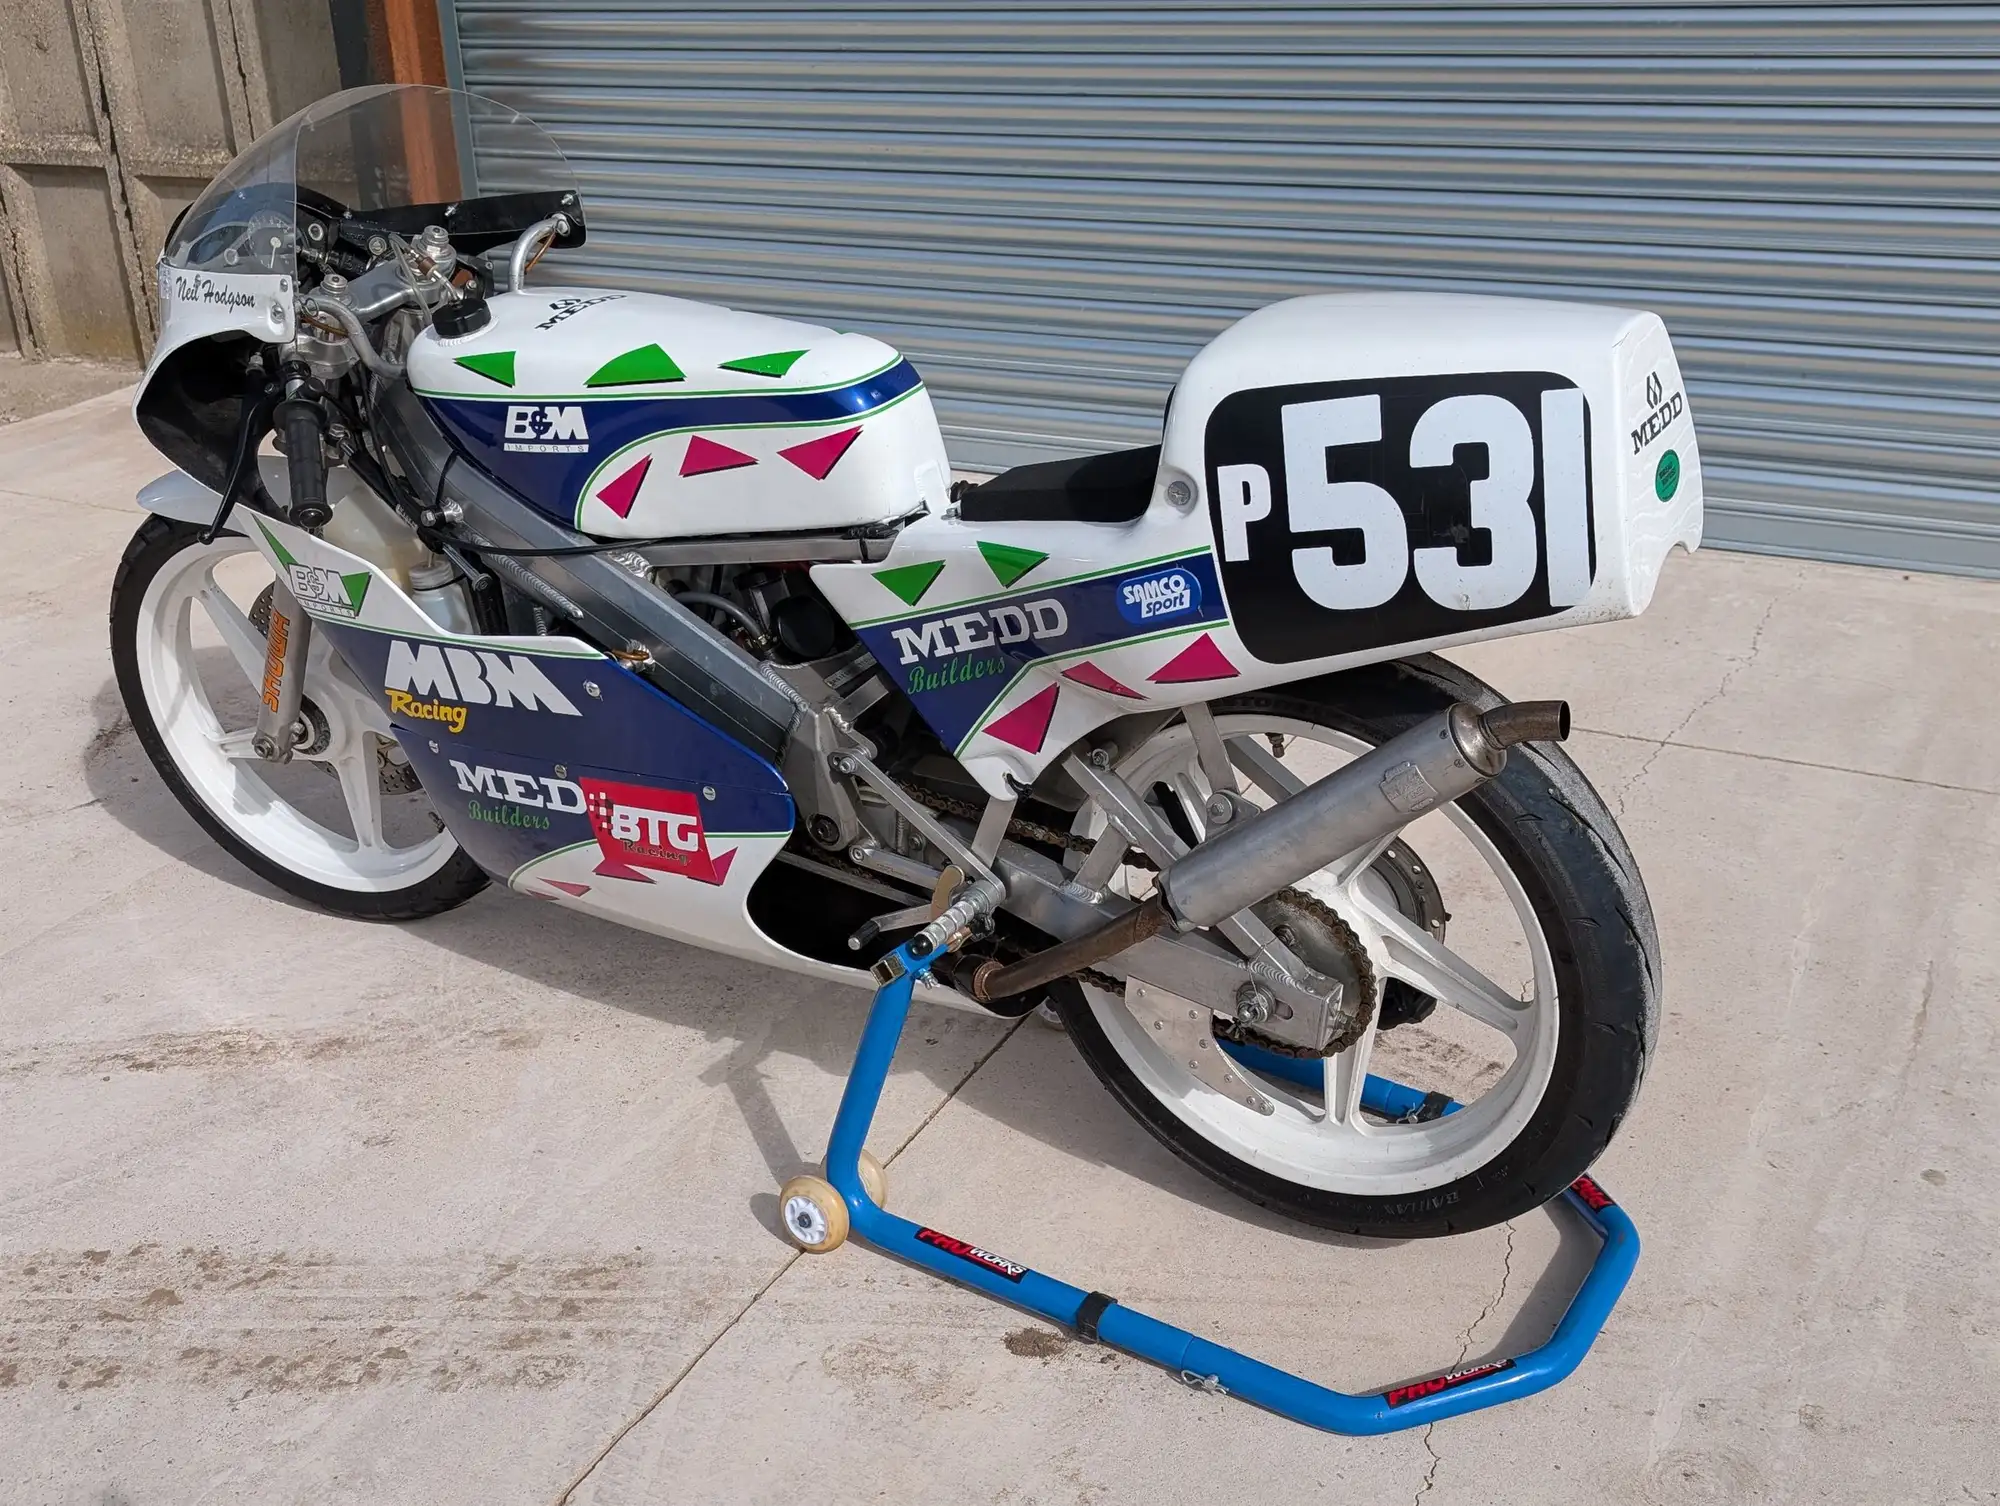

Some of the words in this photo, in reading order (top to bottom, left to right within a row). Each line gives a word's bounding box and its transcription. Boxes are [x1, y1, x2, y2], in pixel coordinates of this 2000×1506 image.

[176, 274, 201, 303] Neil
[201, 279, 256, 313] Hodgson
[534, 294, 628, 331] MEDD
[504, 405, 590, 440] B&M
[1630, 391, 1683, 456] MEDD
[507, 444, 585, 453] IMPORTS
[1217, 463, 1271, 562] P
[1281, 387, 1592, 611] 531
[288, 563, 354, 607] B&M
[1122, 574, 1186, 605] SAMCO
[1145, 592, 1185, 616] sport
[891, 598, 1068, 665] MEDD
[262, 610, 290, 713] SHOWA
[384, 639, 584, 717] MBM
[907, 653, 1006, 695] Builders
[385, 689, 468, 734] Racing
[468, 800, 551, 831] Builders
[611, 804, 699, 853] BTG
[621, 838, 688, 867] Racing
[969, 1246, 1027, 1275] WORKS
